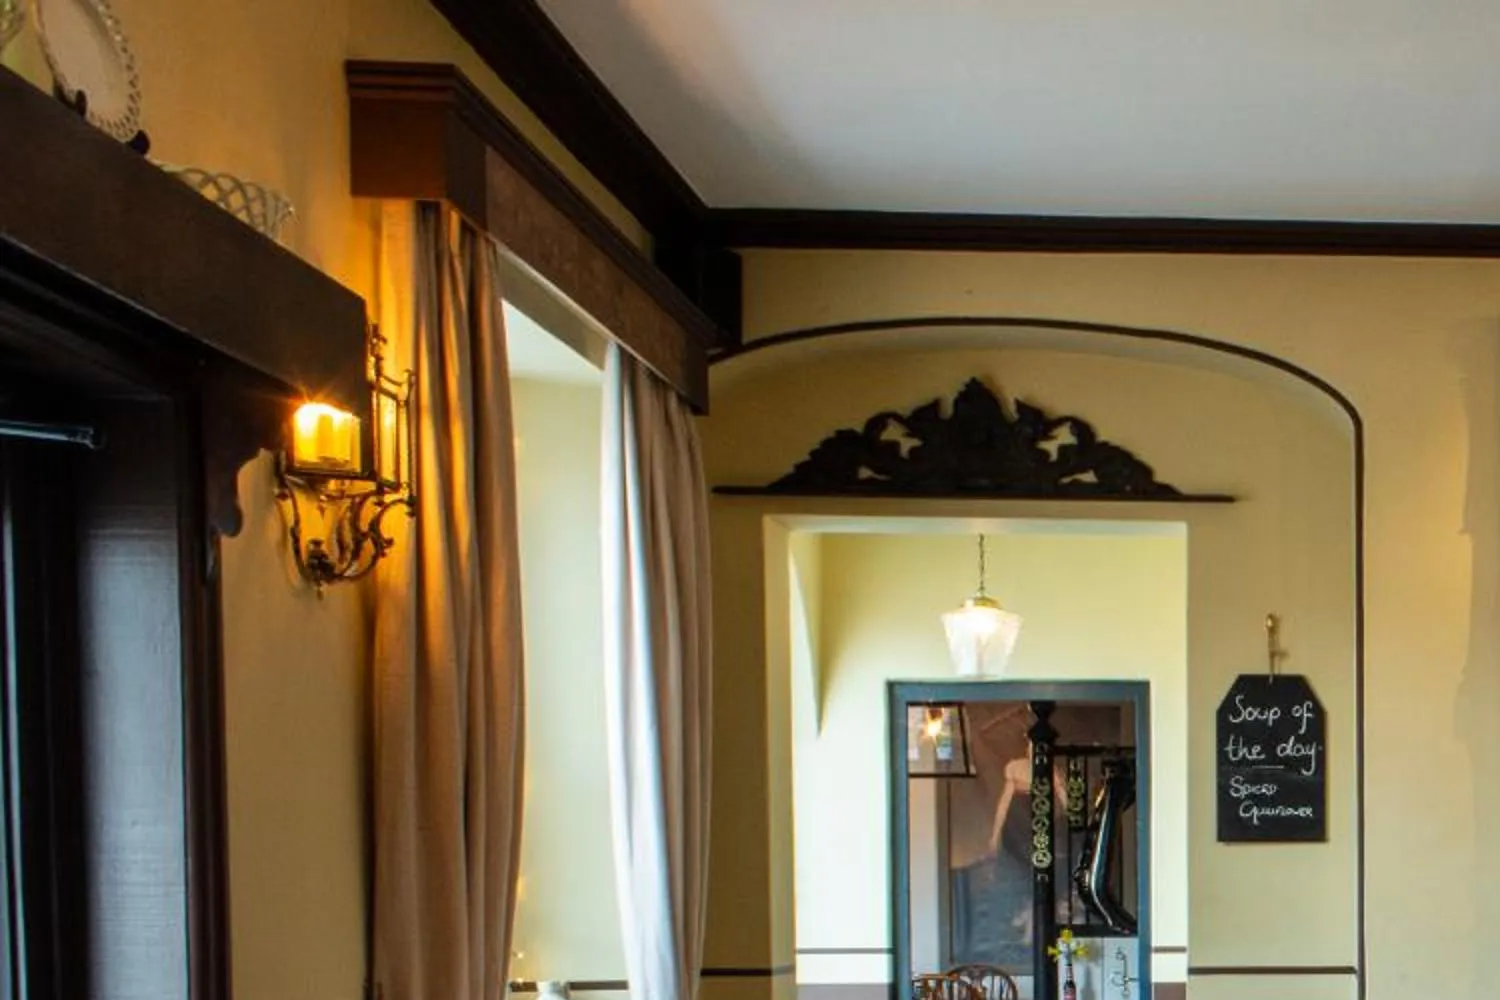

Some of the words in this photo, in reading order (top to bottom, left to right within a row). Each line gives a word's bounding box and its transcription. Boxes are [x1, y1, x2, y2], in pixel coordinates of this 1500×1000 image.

[1229, 694, 1281, 727] Soup
[1291, 701, 1313, 734] of
[1225, 734, 1265, 761] the
